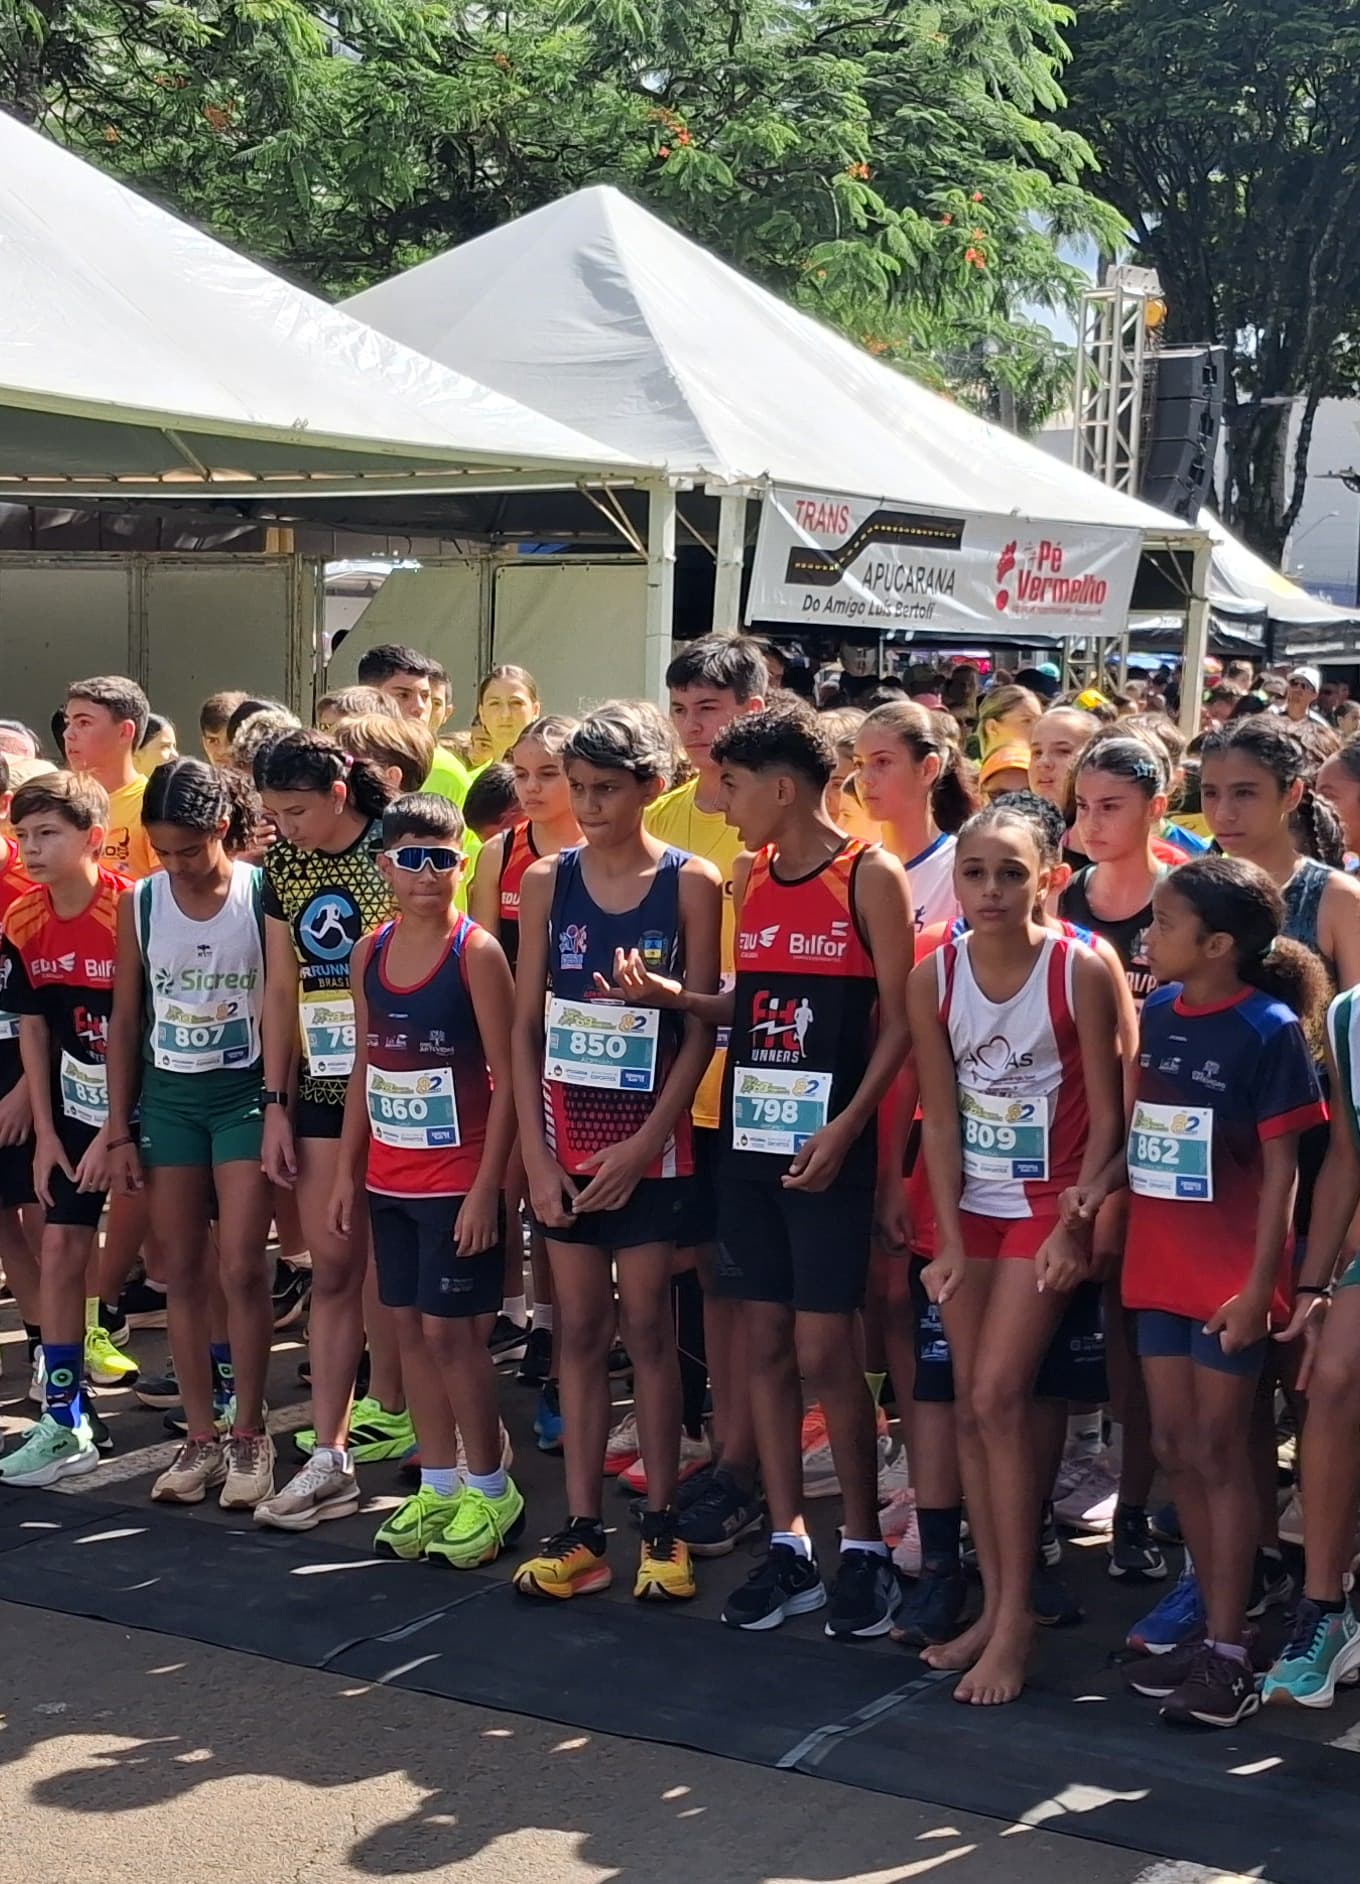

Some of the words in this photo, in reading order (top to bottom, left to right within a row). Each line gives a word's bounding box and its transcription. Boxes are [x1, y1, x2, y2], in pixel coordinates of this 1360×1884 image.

[795, 500, 849, 535] TRANS
[1037, 540, 1062, 573] Pé
[862, 562, 956, 595] APUCARANA
[1018, 569, 1107, 605] Vermelho
[802, 594, 820, 612] Do
[823, 595, 866, 617] Amigo
[894, 602, 936, 620] Bertoli
[790, 933, 848, 957] Bilfor
[85, 959, 115, 978] Bilf
[181, 968, 258, 991] Sicredi
[175, 1024, 225, 1048] 807
[570, 1031, 627, 1059] 850
[380, 1097, 428, 1120] 860
[751, 1098, 799, 1124] 798
[966, 1119, 1017, 1151] 809
[1137, 1135, 1180, 1164] 862
